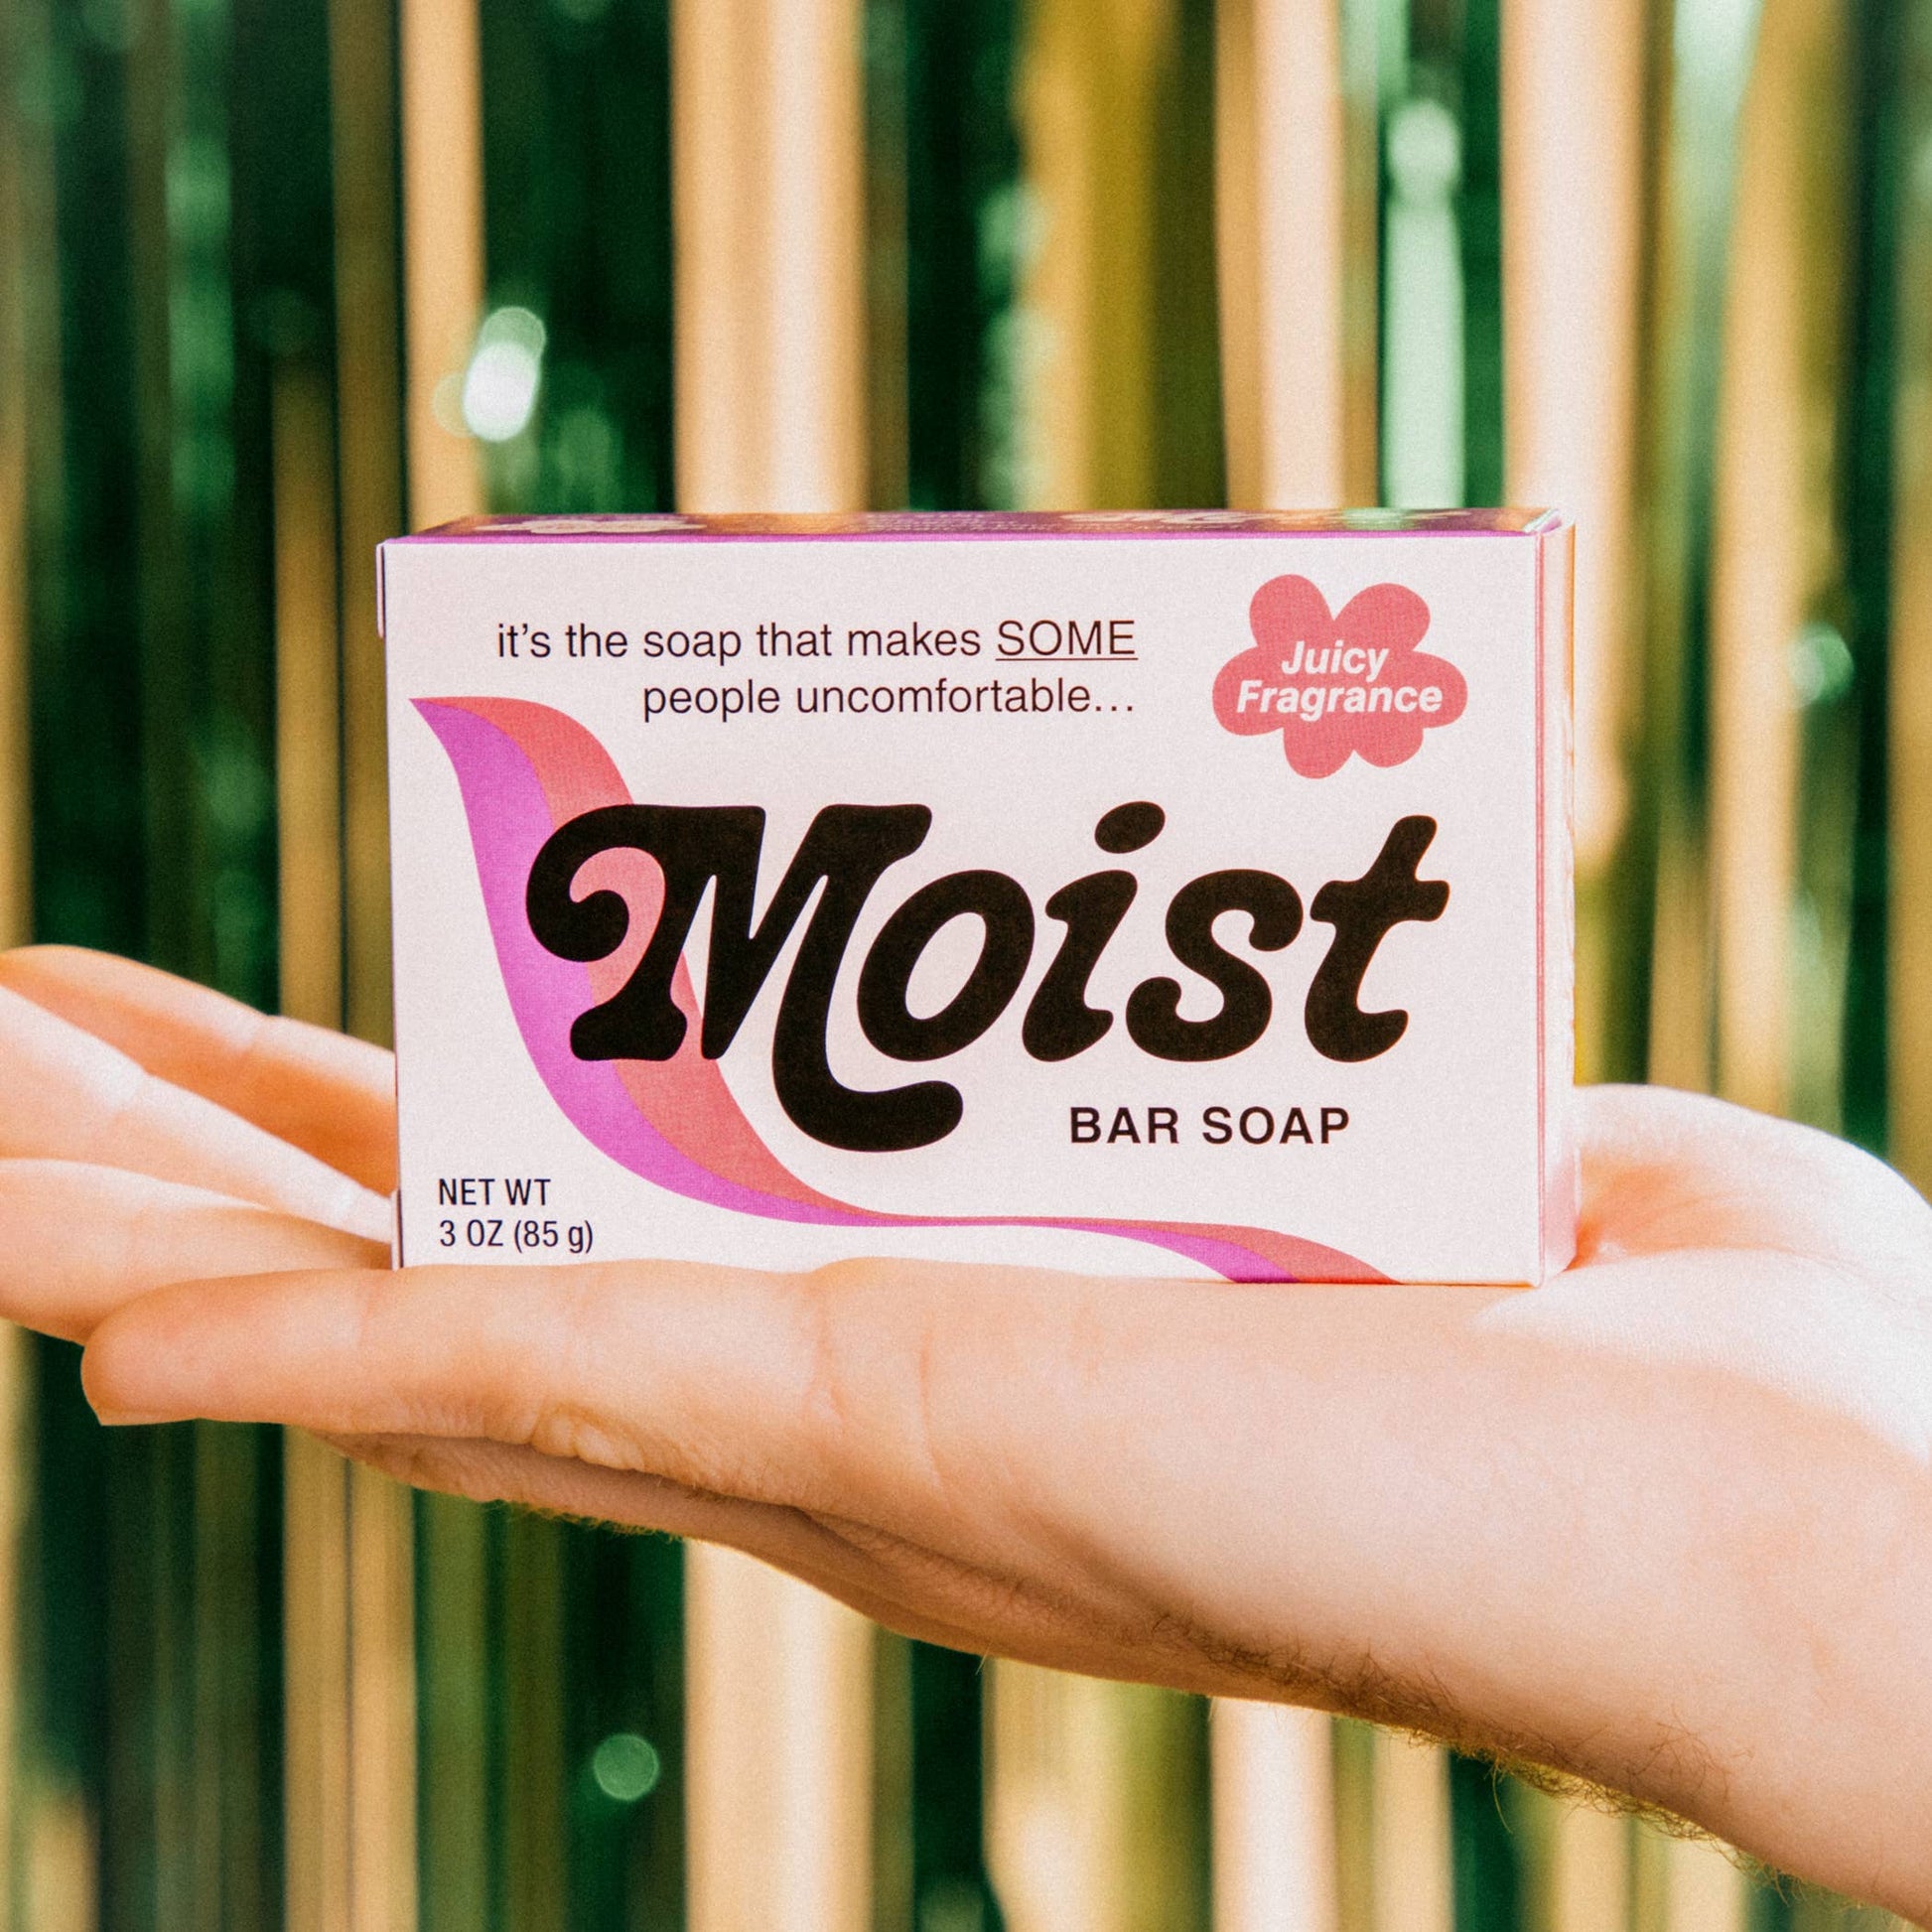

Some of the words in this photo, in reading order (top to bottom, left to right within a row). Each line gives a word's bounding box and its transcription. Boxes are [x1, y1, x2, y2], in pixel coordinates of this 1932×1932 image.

[565, 622, 628, 658] the
[642, 628, 743, 667] soap
[756, 621, 833, 657] that
[848, 621, 981, 657] makes
[996, 620, 1138, 659] SOME
[1281, 639, 1390, 683] Juicy
[643, 678, 780, 724] people
[1236, 680, 1444, 723] Fragrance
[526, 801, 1450, 1153] Moist
[1070, 1106, 1179, 1145] BAR
[1202, 1105, 1350, 1146] SOAP
[439, 1177, 495, 1206] NET
[504, 1177, 552, 1206] WT
[439, 1219, 457, 1247] 3
[467, 1218, 504, 1247] OZ
[513, 1219, 559, 1254] (85
[568, 1219, 594, 1254] g)
